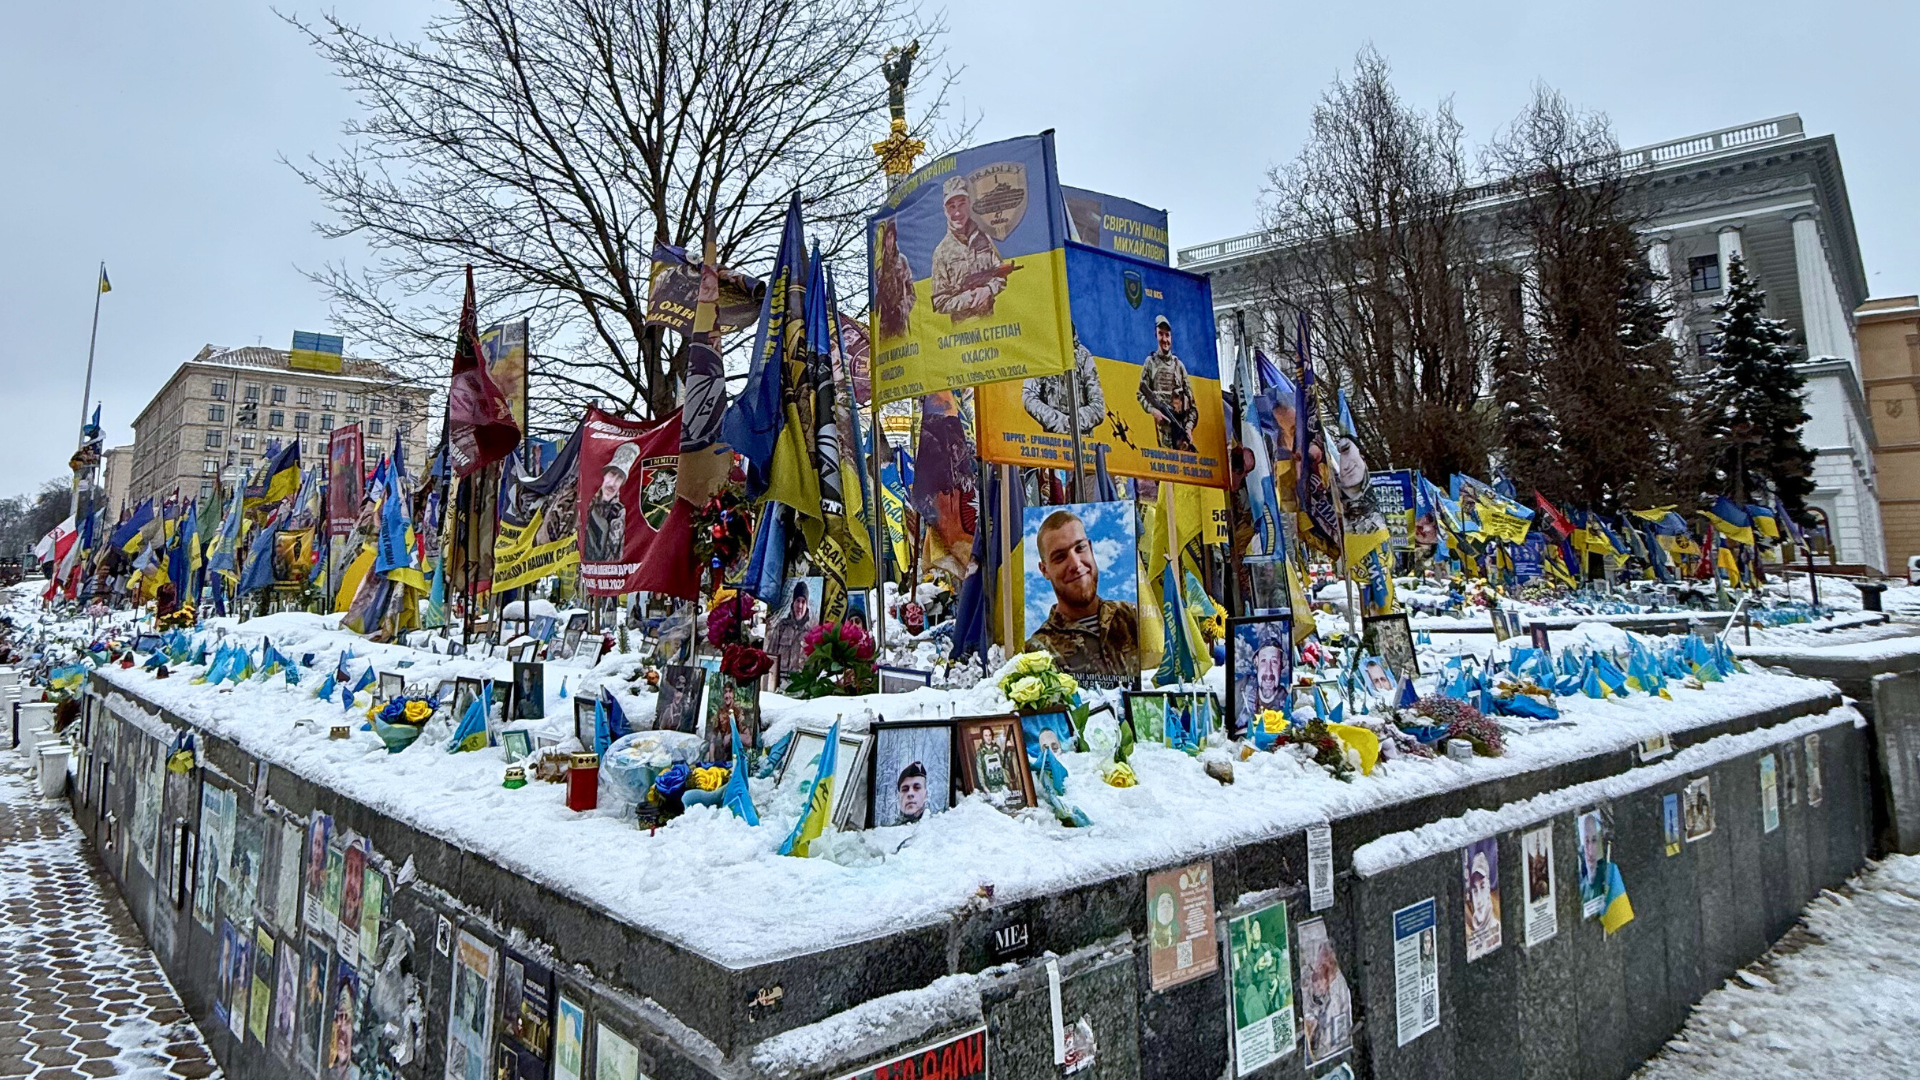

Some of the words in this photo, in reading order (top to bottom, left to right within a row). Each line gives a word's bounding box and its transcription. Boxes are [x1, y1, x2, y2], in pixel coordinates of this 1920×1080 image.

[970, 164, 1026, 184] BRADLEY
[1103, 214, 1141, 237] СВІРГУН
[1113, 236, 1166, 262] МИХАЙЛОВИЧ
[937, 327, 982, 350] ЗАГРИВИЙ
[983, 322, 1022, 342] СТЕПАН
[961, 346, 1000, 365] «ХАСКІ»
[650, 456, 680, 465] IMMITI
[527, 550, 555, 571] НАШИХ
